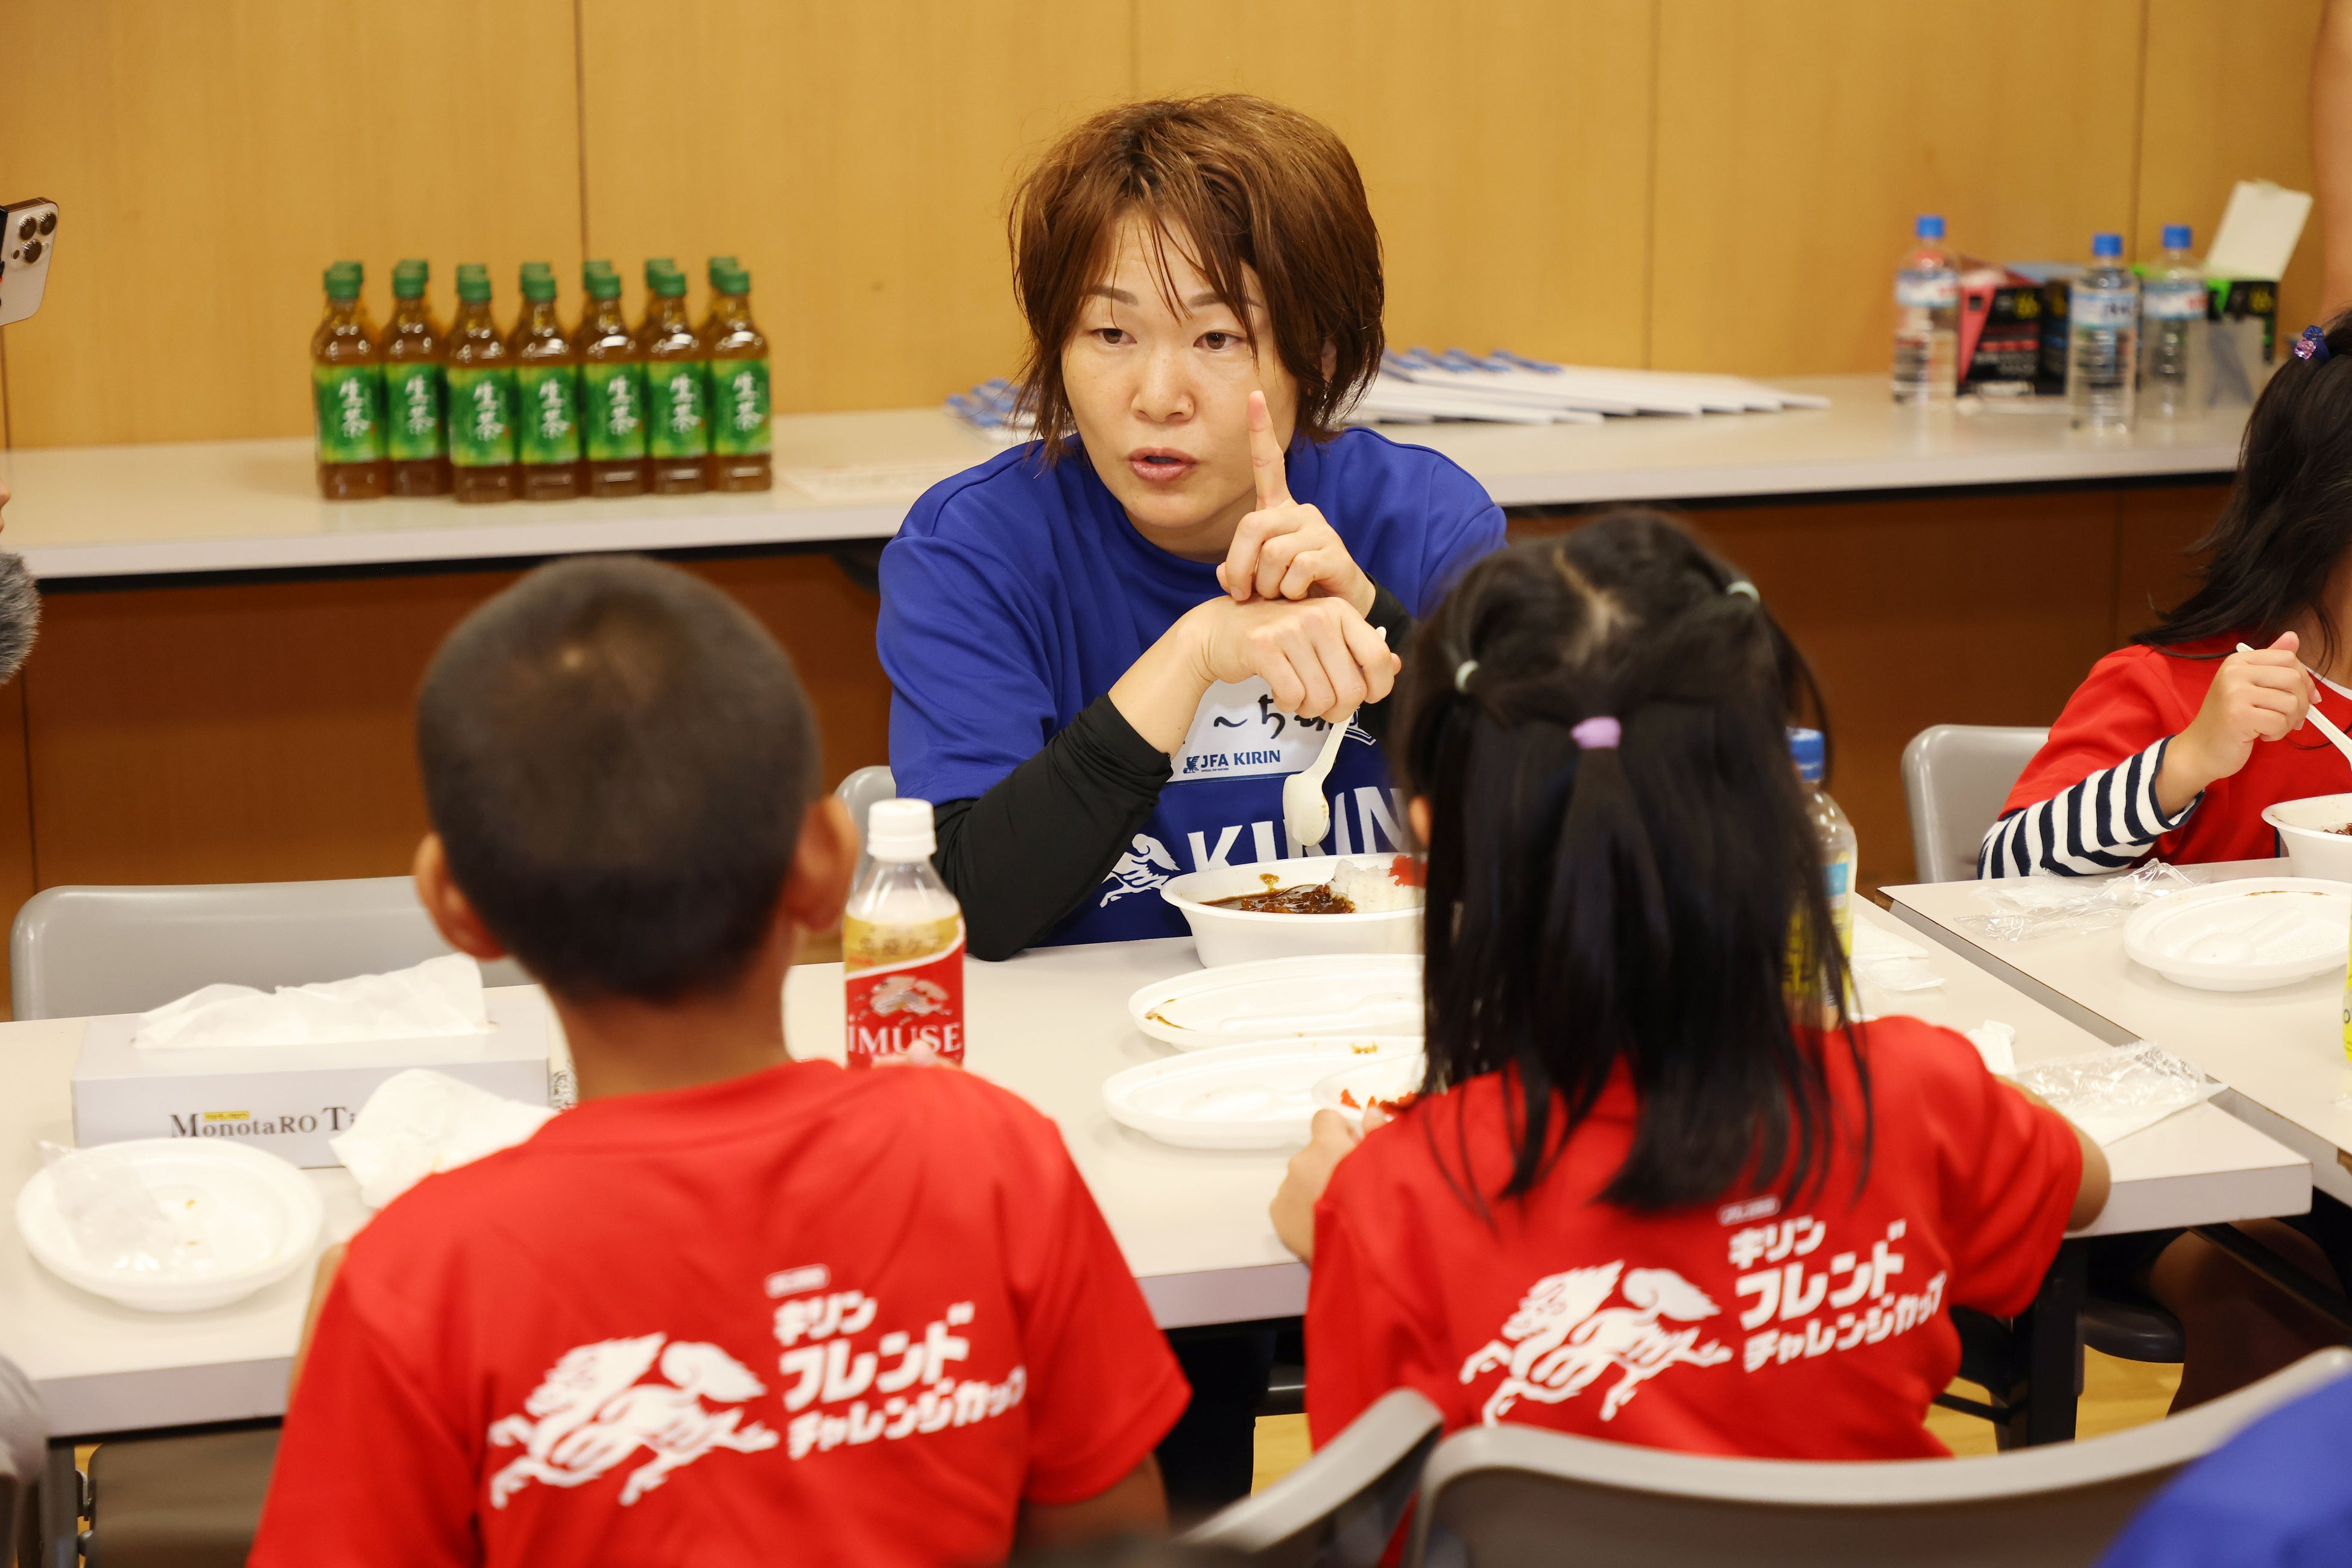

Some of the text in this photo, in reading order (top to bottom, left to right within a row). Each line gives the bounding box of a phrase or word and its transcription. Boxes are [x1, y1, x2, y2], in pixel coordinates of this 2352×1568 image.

[340, 378, 371, 438] 生茶
[405, 375, 436, 435] 生茶
[473, 380, 505, 441] 生茶
[540, 378, 571, 439] 生茶
[607, 375, 639, 435] 生茶
[670, 373, 702, 434] 生茶
[733, 371, 763, 431] 生茶
[1201, 750, 1280, 768] JFA KIRIN
[170, 1113, 317, 1138] MonotaRO
[1728, 1215, 1826, 1269] キリン
[1736, 1218, 1907, 1330] フレンド
[774, 1289, 878, 1346] キリン
[1743, 1271, 1947, 1373] チャレンジカップ
[779, 1300, 976, 1412] フレンド
